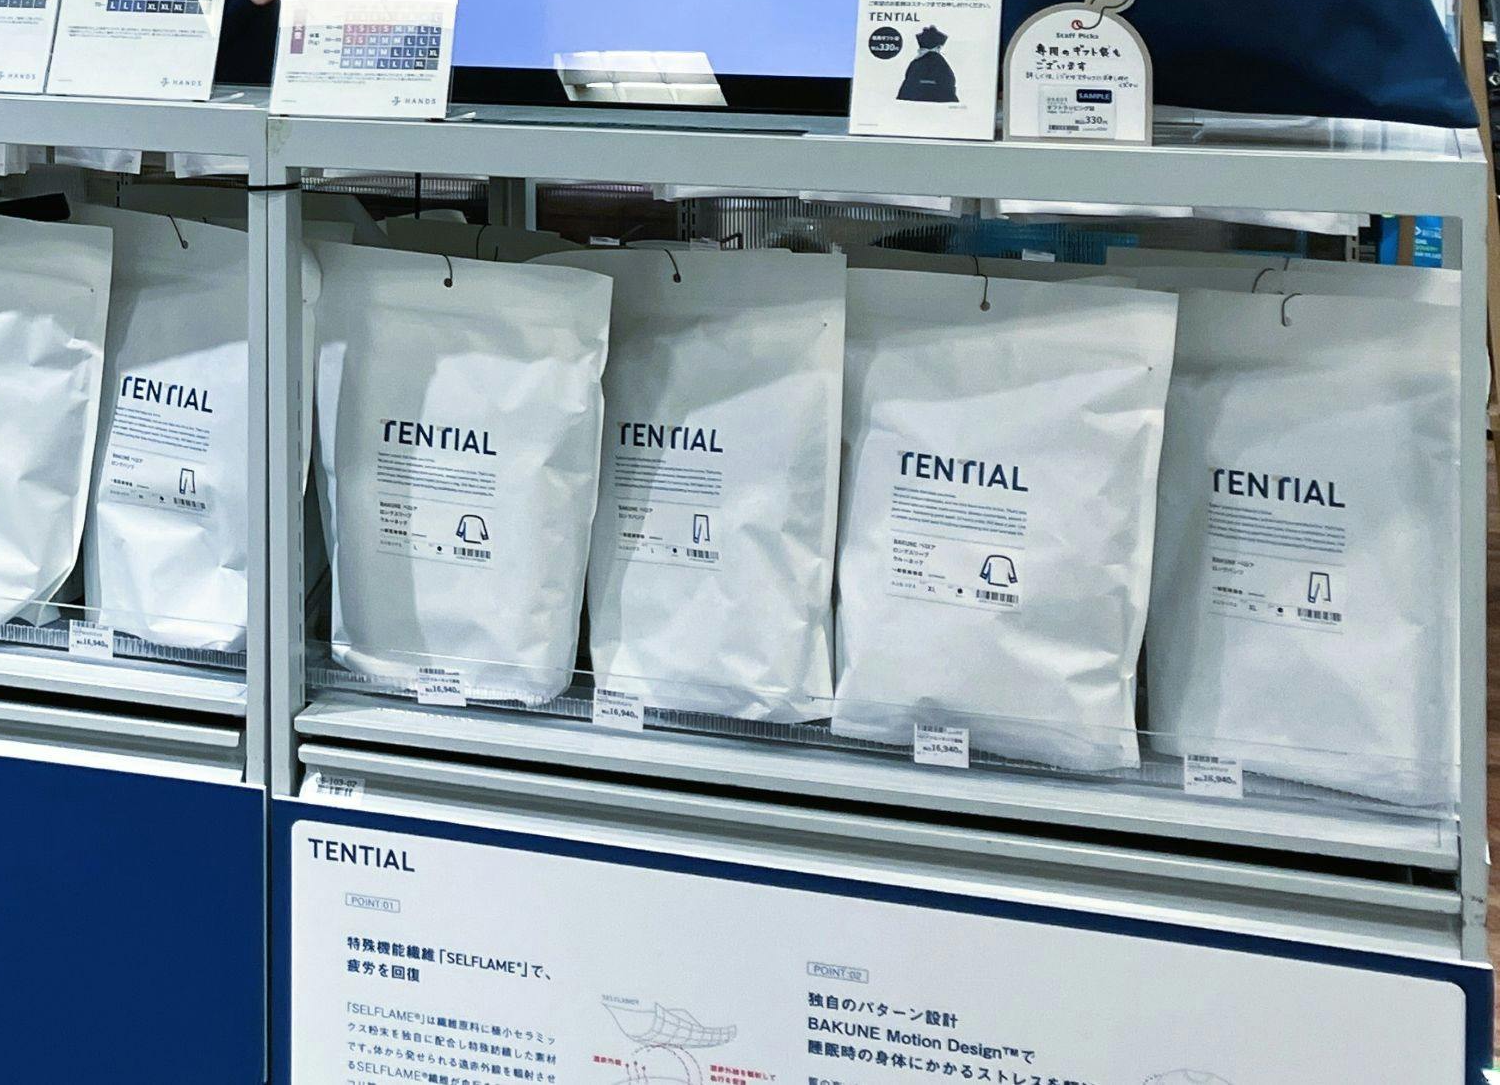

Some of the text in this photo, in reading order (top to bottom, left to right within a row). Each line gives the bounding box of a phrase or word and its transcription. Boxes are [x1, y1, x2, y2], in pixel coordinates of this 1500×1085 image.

[869, 12, 921, 22] TENTIAL
[120, 375, 214, 415] TENTIAL
[379, 418, 498, 457] TENTIAL
[616, 421, 724, 454] TENTIAL
[898, 450, 1029, 493] TENTIAL
[1208, 465, 1347, 509] TENTIAL
[308, 837, 416, 873] TENTIAL
[351, 895, 381, 908] POINT
[346, 959, 420, 983] 疲労を回復
[808, 992, 958, 1029] 独自のパターン設計
[808, 1017, 881, 1041] BAKUNE
[886, 1029, 942, 1050] Motion
